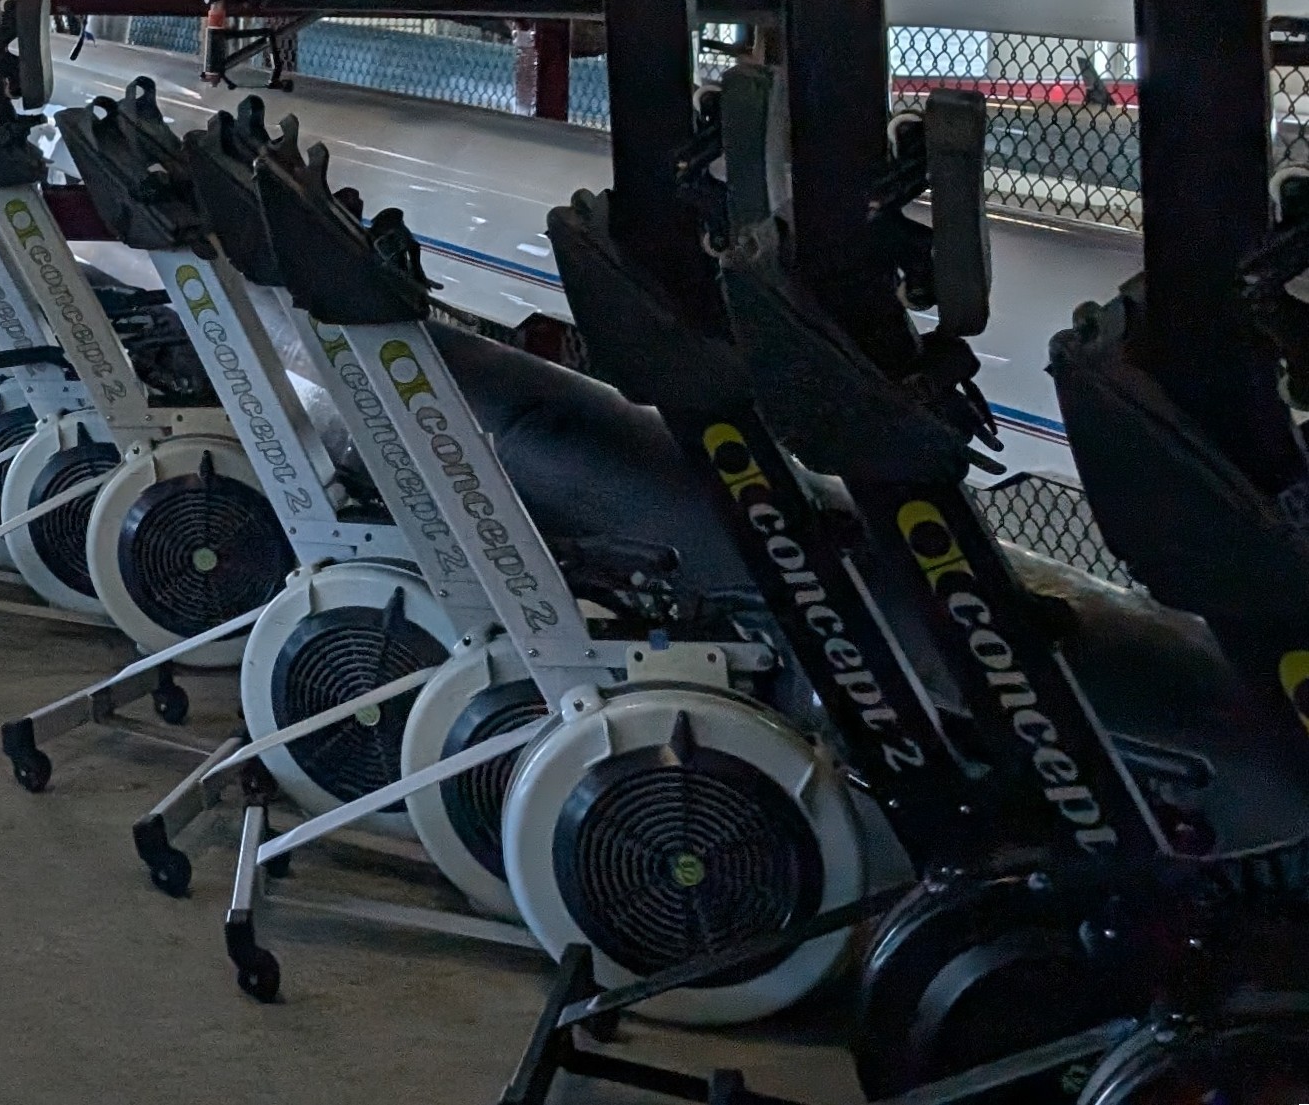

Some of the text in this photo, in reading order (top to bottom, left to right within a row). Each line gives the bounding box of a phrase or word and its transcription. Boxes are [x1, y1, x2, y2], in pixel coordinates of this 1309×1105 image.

[29, 244, 127, 404] concept 2
[203, 320, 313, 515] concept 2
[339, 363, 468, 576] concept 2
[415, 406, 559, 634] concept 2
[748, 502, 926, 772] concept 2
[948, 591, 1119, 854] concept
